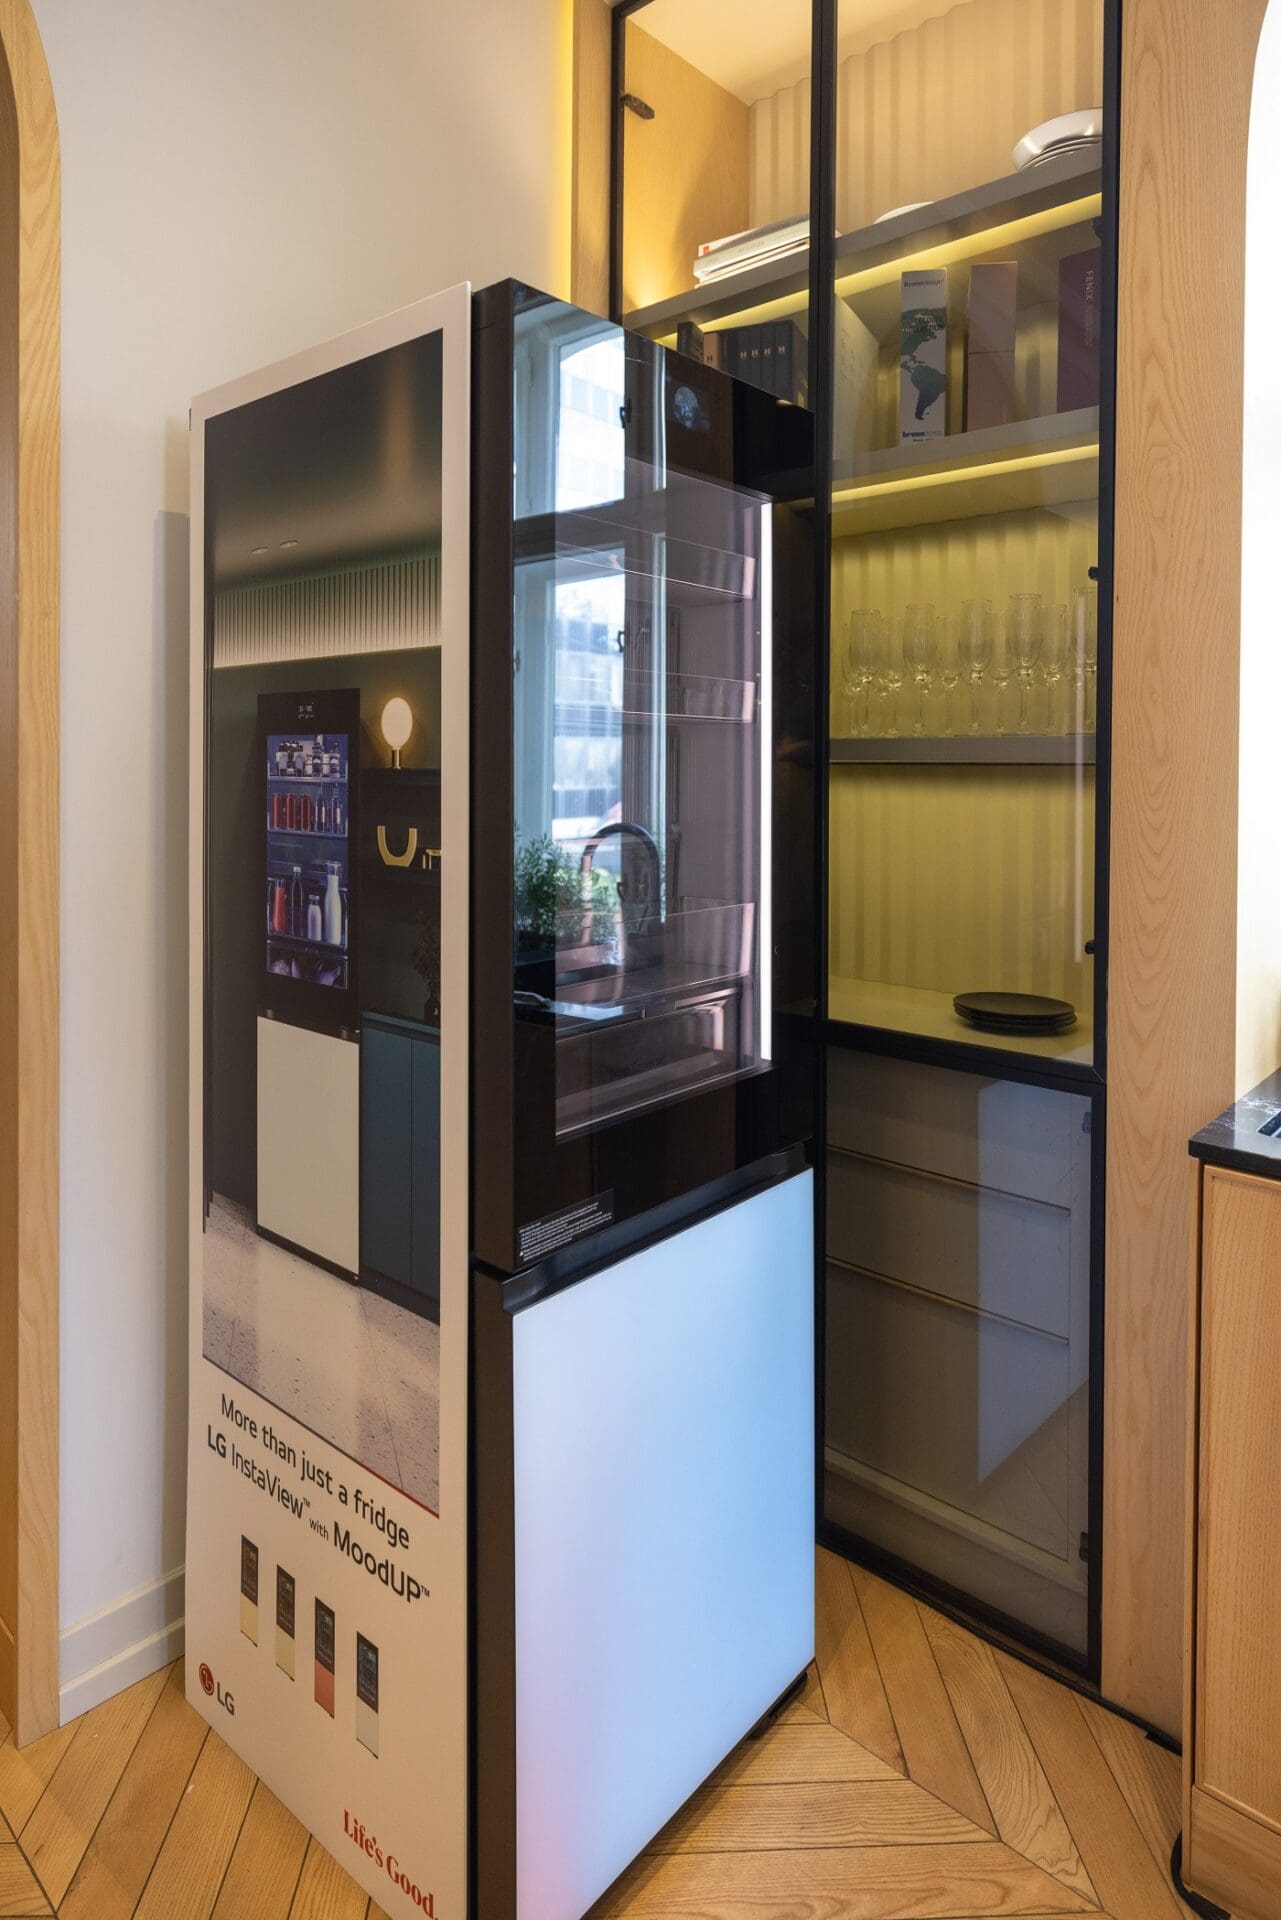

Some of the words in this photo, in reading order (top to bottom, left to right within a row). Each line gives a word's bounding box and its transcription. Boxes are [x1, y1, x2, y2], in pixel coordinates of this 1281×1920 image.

[1085, 269, 1095, 302] FENIX
[207, 1424, 227, 1459] LG
[309, 1517, 329, 1541] with
[221, 1393, 258, 1439] More
[261, 1425, 297, 1468] than
[300, 1451, 333, 1495] just
[338, 1484, 348, 1506] a
[354, 1489, 410, 1550] fridge
[217, 1681, 235, 1716] LG
[343, 1809, 384, 1869] Life's
